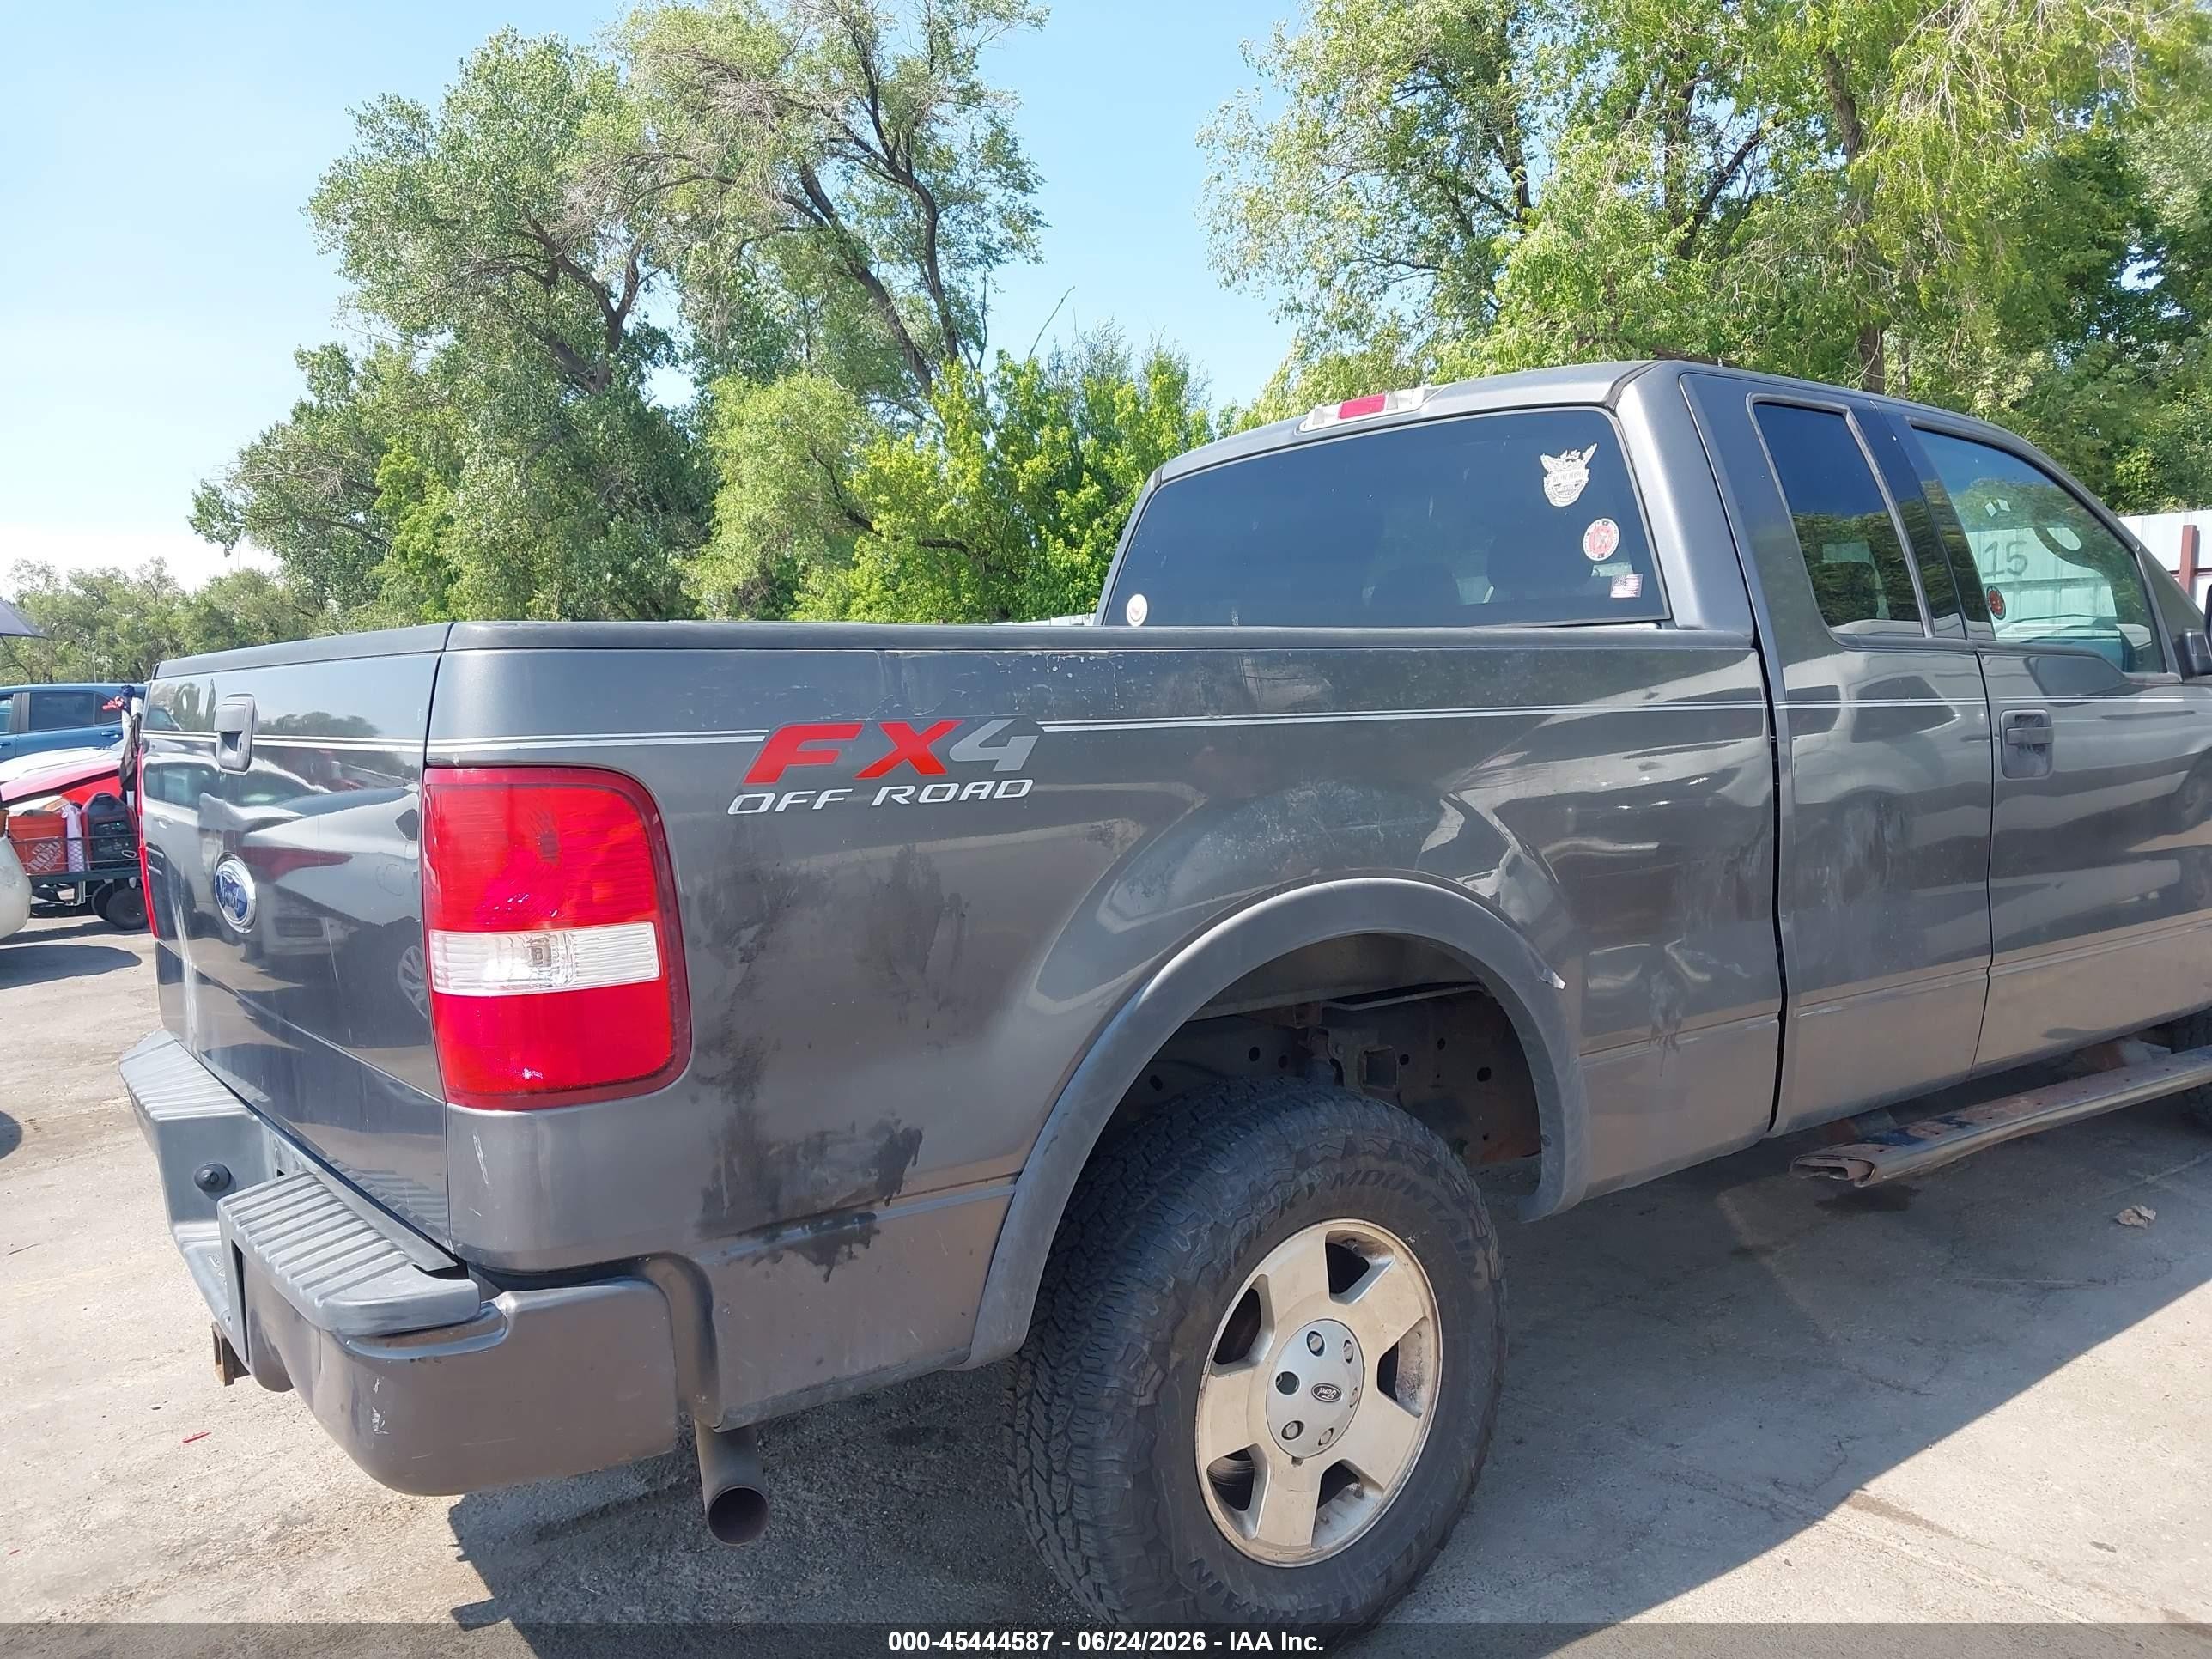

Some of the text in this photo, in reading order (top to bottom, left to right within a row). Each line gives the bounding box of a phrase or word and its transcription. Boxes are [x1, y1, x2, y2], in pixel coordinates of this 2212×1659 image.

[1983, 540, 2029, 579] 15
[742, 719, 1039, 786] FX4
[727, 779, 1034, 815] OFF ROAD
